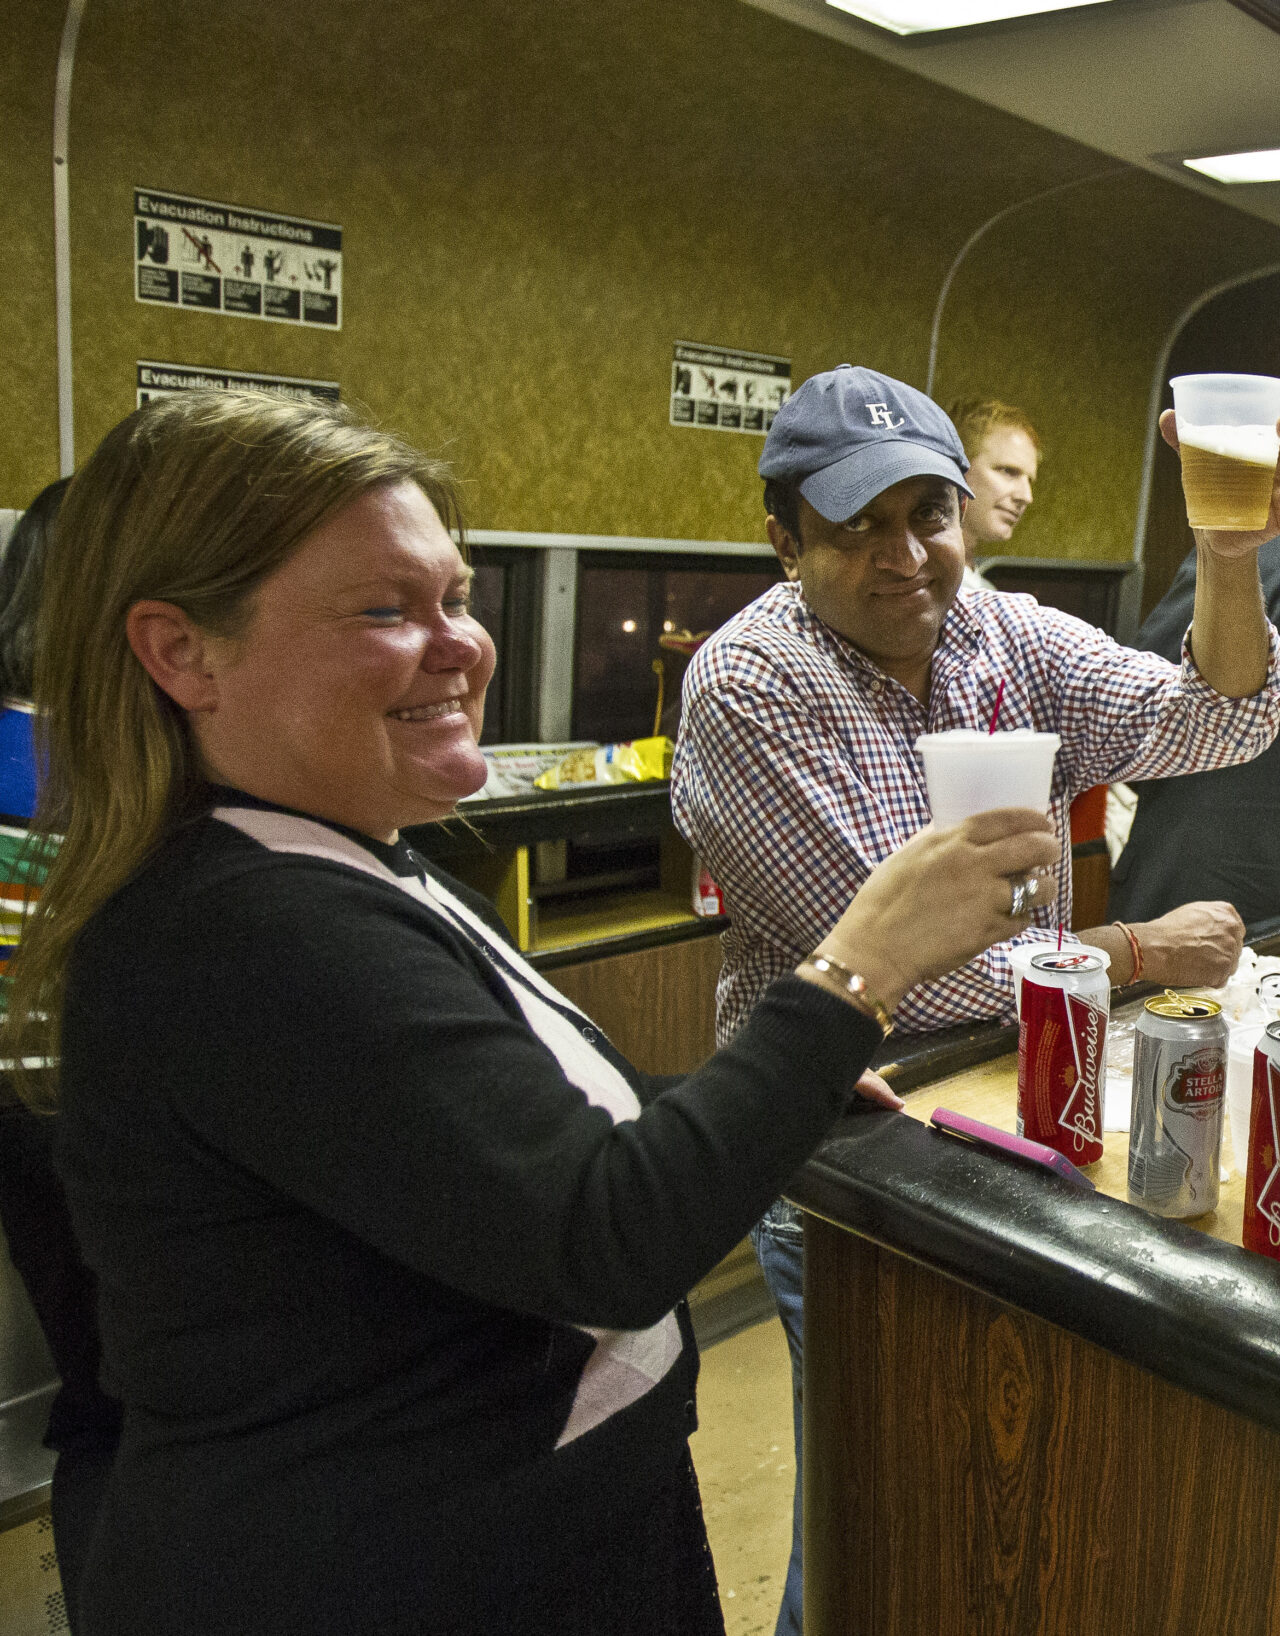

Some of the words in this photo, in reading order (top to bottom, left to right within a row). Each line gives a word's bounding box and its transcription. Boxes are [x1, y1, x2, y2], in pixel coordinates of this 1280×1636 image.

[138, 196, 225, 227] Evacuation
[228, 215, 313, 243] Instructions
[140, 369, 224, 389] Evacuation
[865, 402, 905, 430] FL
[1073, 993, 1099, 1153] Budweiser
[1186, 1073, 1223, 1088] STELLA
[1185, 1083, 1223, 1097] ARTOIS
